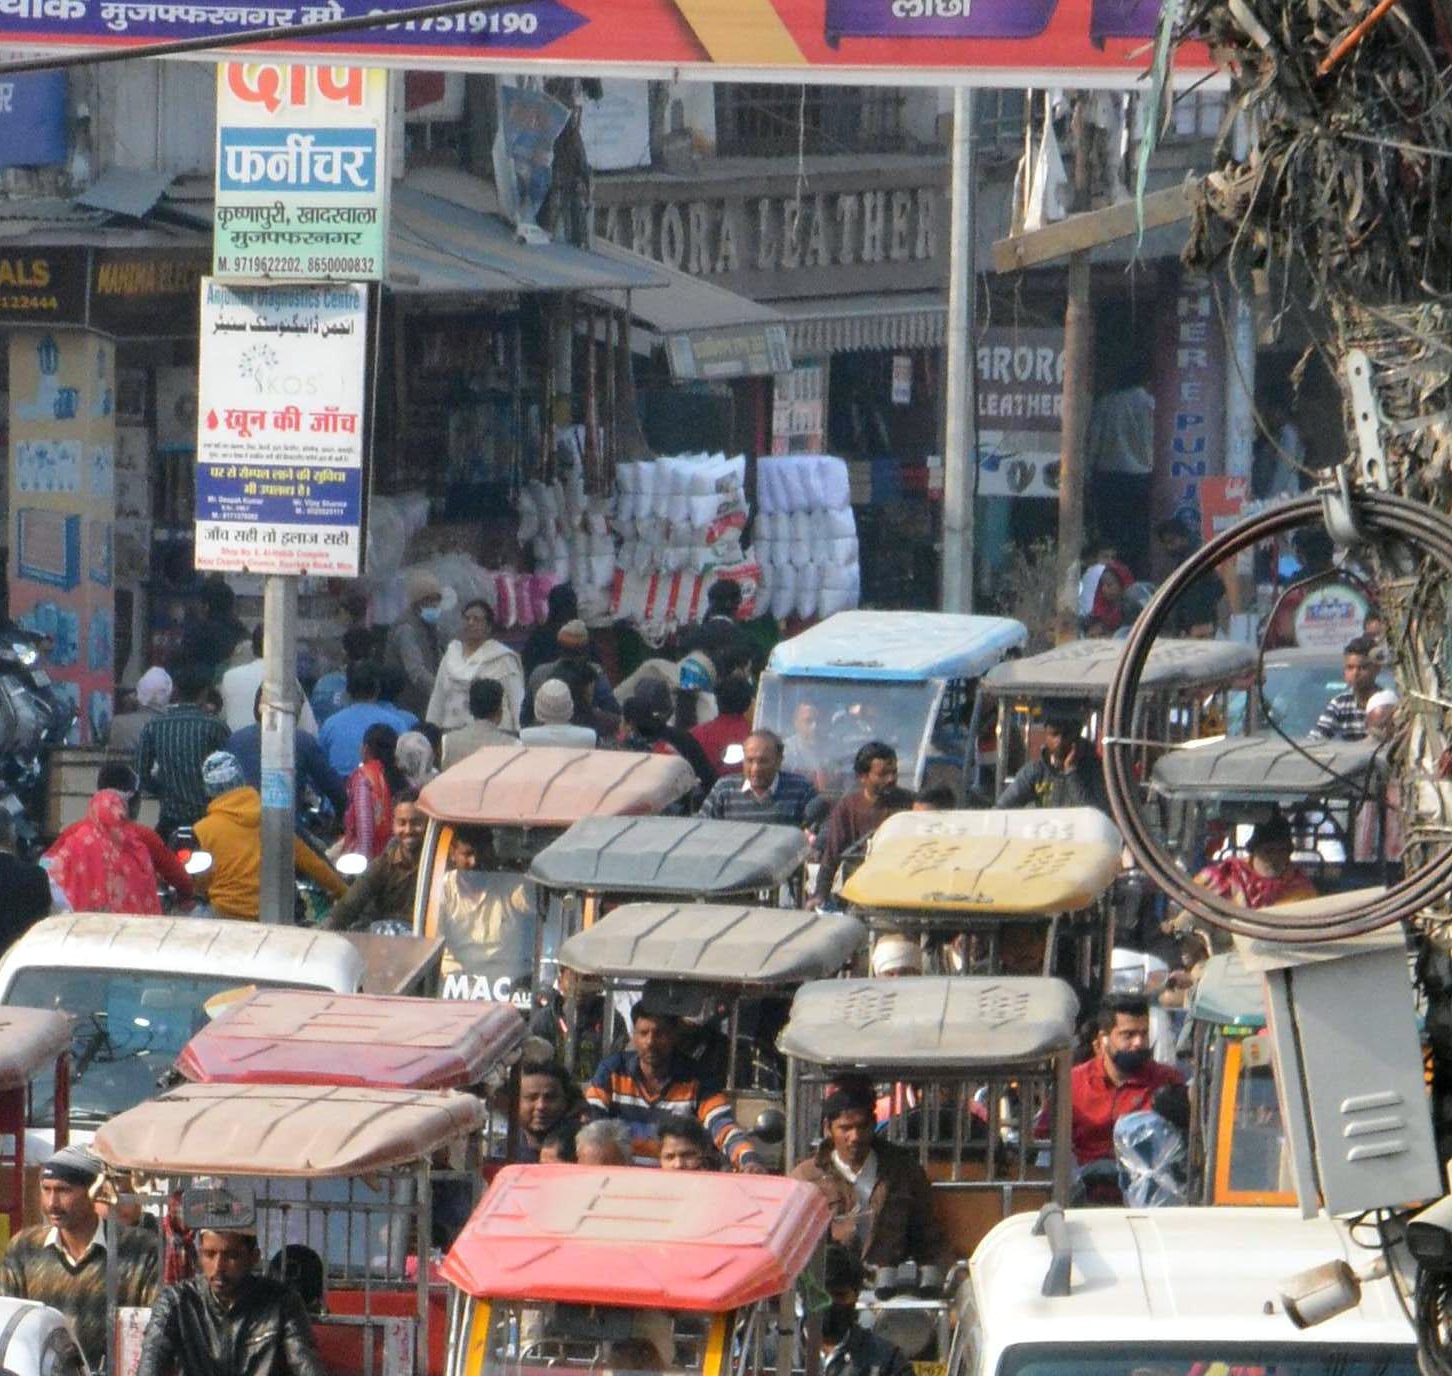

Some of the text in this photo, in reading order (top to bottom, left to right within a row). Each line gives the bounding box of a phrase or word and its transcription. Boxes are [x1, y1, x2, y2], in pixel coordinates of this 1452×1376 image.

[225, 133, 373, 187] फर्नीचर
[230, 231, 364, 249] मुजफ्फरनगर
[217, 256, 230, 273] M.
[307, 256, 375, 274] 8650000832
[223, 408, 268, 438] खून
[271, 404, 303, 432] की
[234, 527, 259, 544] सही
[262, 528, 277, 544] तो
[323, 530, 350, 547] सही
[441, 973, 512, 1002] MAC
